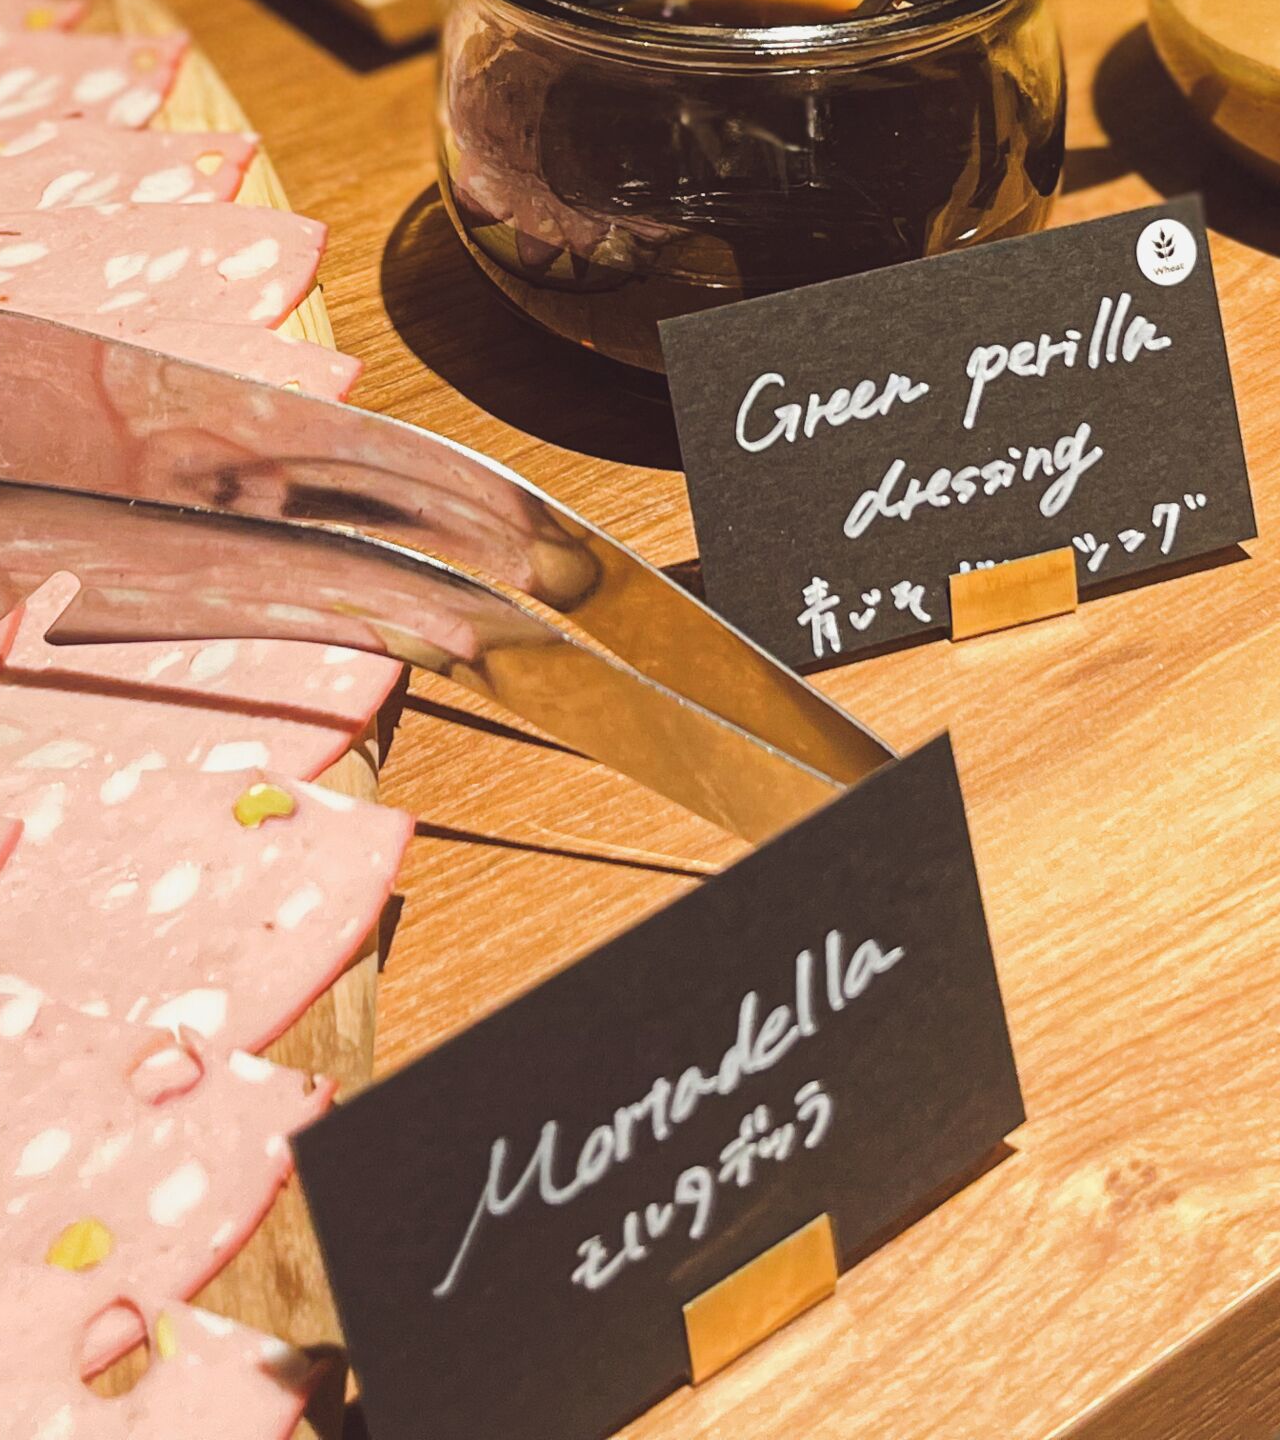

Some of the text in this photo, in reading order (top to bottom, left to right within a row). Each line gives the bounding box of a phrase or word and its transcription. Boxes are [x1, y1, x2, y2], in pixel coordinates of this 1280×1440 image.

[1153, 263, 1185, 276] Wheat
[735, 292, 1172, 453] Green perilla
[843, 422, 1103, 540] dressing
[433, 929, 906, 1298] Mortadella
